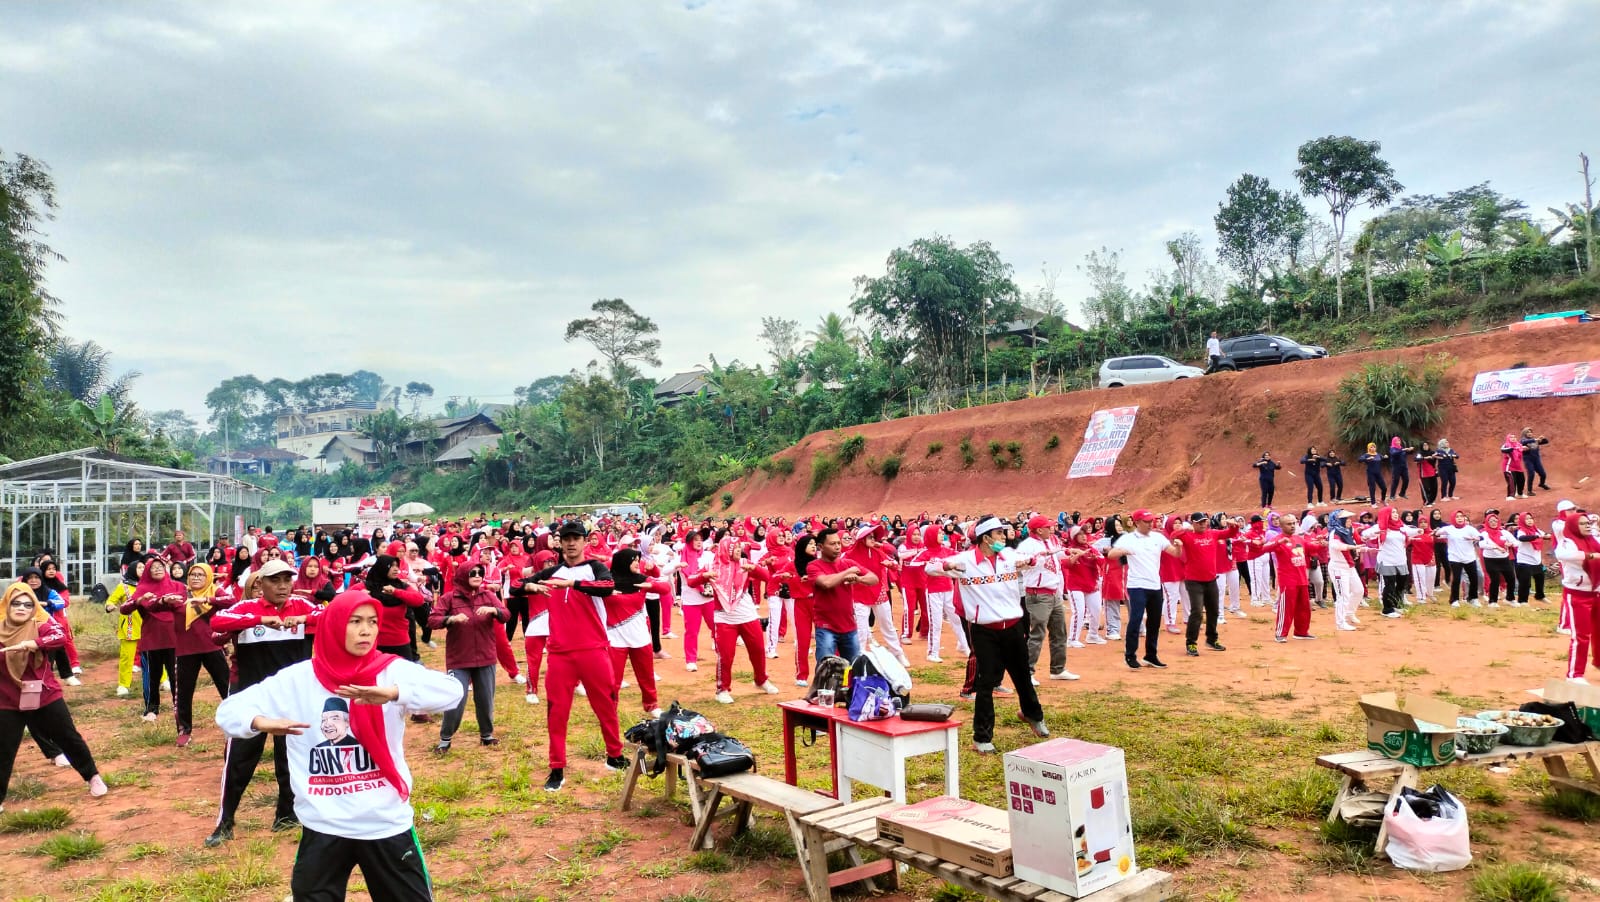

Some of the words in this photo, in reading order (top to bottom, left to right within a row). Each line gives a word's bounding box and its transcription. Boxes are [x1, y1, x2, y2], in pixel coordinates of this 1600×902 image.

[1081, 439, 1124, 453] BERSAMA
[1015, 764, 1035, 776] KIRIN
[1077, 766, 1097, 778] KIRIN
[308, 781, 386, 795] INDONESIA
